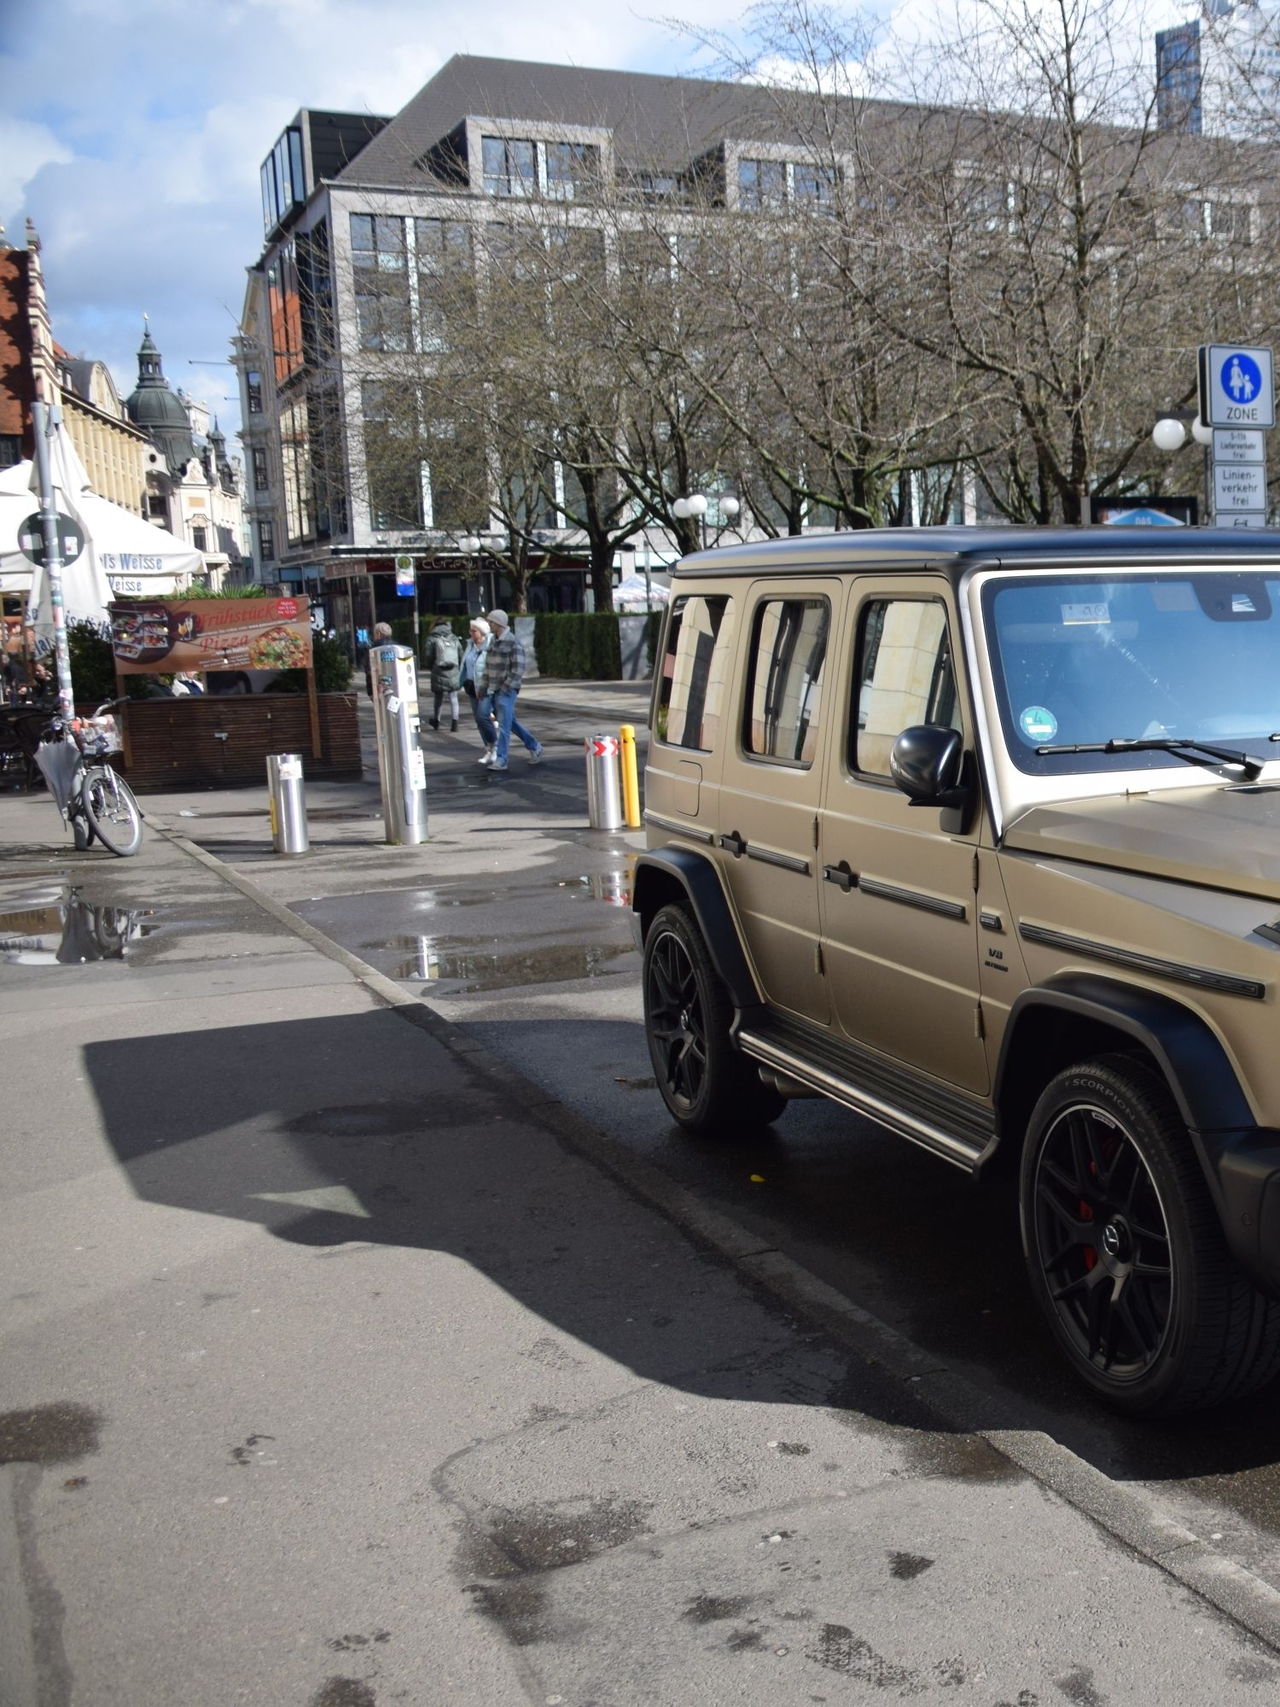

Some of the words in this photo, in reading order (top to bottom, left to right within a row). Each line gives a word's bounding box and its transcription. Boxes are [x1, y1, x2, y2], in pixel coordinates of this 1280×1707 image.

[1226, 407, 1258, 420] ZONE
[1222, 469, 1256, 480] Linien-
[1221, 483, 1258, 493] verkehr
[1232, 496, 1249, 505] frei
[119, 554, 163, 570] Weisse
[196, 602, 278, 630] Frühstück
[201, 635, 249, 652] Pizza
[1072, 1078, 1136, 1120] SCORPION
